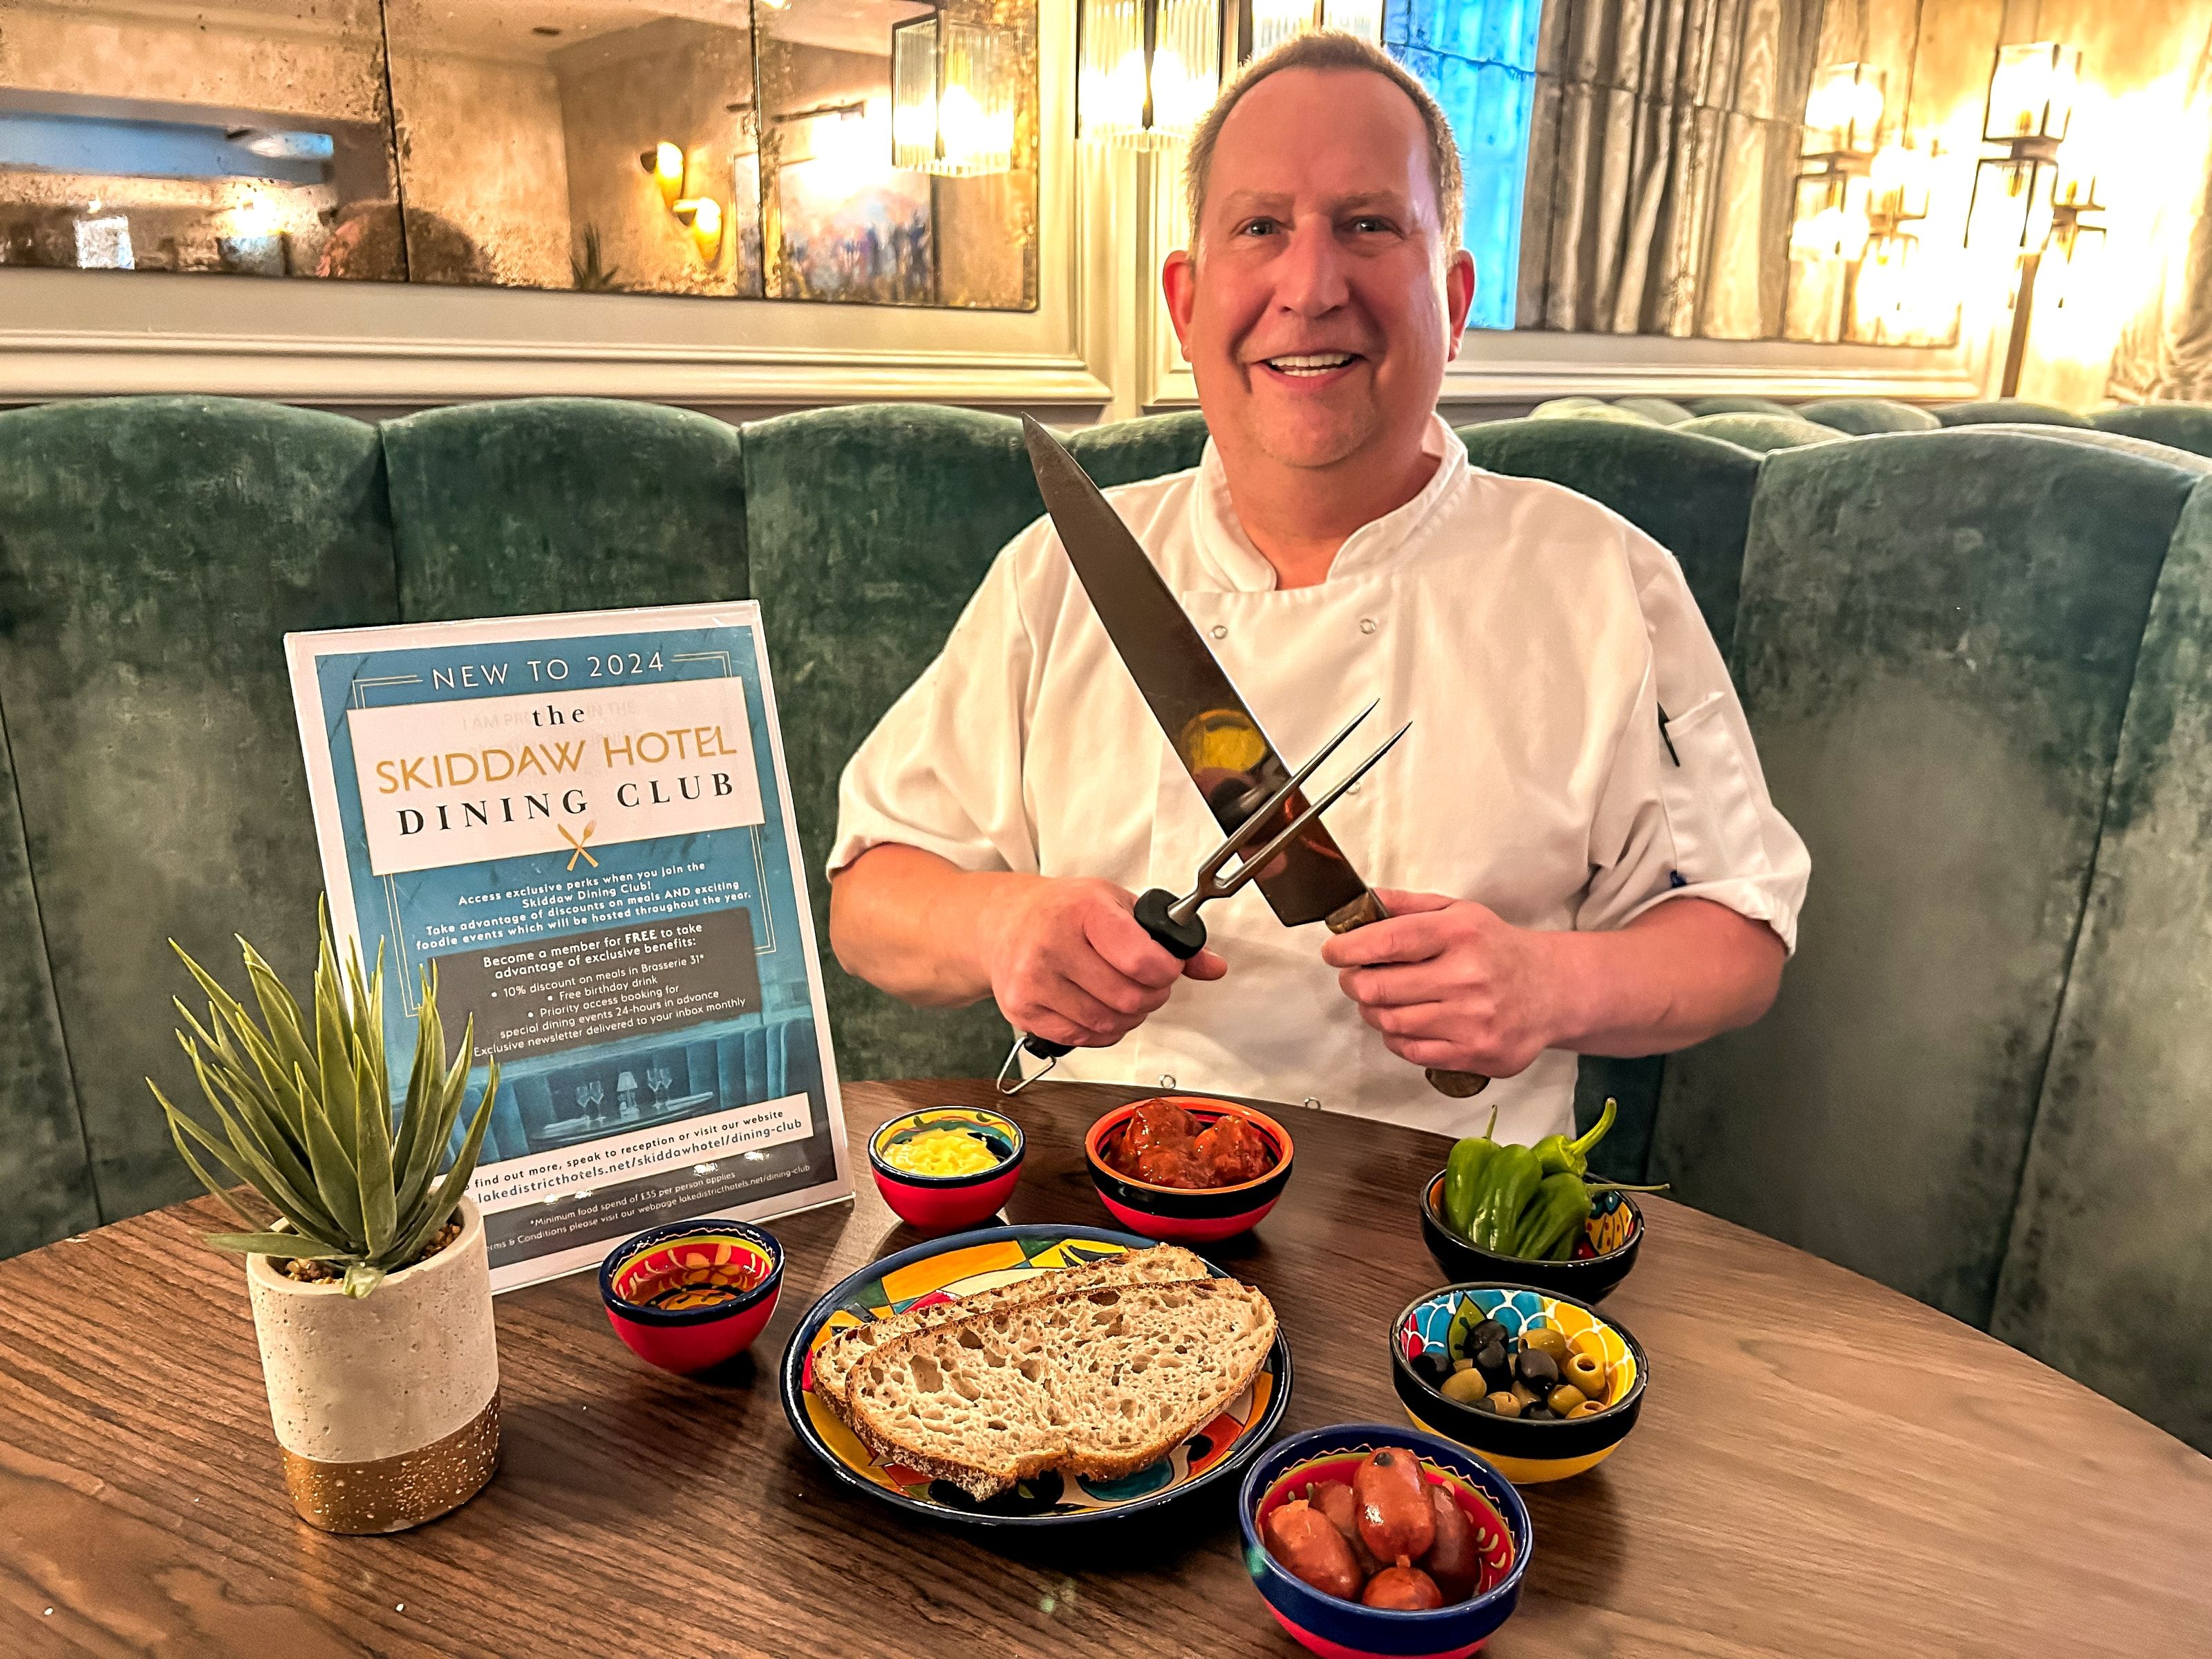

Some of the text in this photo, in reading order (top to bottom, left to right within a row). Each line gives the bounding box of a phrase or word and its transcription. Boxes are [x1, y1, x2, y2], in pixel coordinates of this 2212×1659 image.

[432, 652, 664, 690] NEW TO 2024
[532, 704, 585, 727] the
[376, 739, 587, 794] SKIDDAW
[603, 726, 737, 768] HOTEL
[396, 772, 733, 836] DINING CLUB
[458, 862, 705, 906] Access exclusive perks when you join the
[522, 881, 651, 909] Skiddaw Dining Club!
[416, 891, 751, 951] foodie events which will be hosted throughout the year.
[426, 881, 740, 937] Take advantage of discounts on meals AND exciting
[483, 924, 702, 968] Become a member for FREE to take
[495, 937, 697, 980] advantage of exclusive benefits:
[503, 984, 527, 997] 10%
[529, 977, 576, 993] discount
[579, 975, 593, 984] on
[596, 968, 626, 982] meals
[629, 966, 639, 975] in
[641, 957, 687, 973] Brasserie
[559, 975, 658, 1002] Free birthday drink
[500, 990, 720, 1040] special dining events 24-hours in advance
[540, 985, 679, 1018] Priority access booking for
[474, 997, 746, 1057] Exclusive newsletter delivered to your inbox monthly
[474, 1174, 499, 1188] find
[504, 1170, 524, 1181] out
[529, 1163, 563, 1177] more,
[567, 1152, 601, 1168] speak
[605, 1150, 617, 1159] to
[621, 1136, 675, 1155] reception
[694, 1126, 718, 1137] visit
[722, 1121, 740, 1131] our
[743, 1110, 783, 1125] website
[578, 1205, 599, 1217] food
[601, 1197, 627, 1210] spend
[629, 1194, 639, 1205] of
[640, 1190, 657, 1201] £35
[658, 1187, 673, 1198] per
[675, 1179, 704, 1194] person
[706, 1172, 735, 1185] applies
[517, 1226, 567, 1245] Conditions
[570, 1217, 598, 1233] please
[601, 1212, 619, 1223] visit
[621, 1210, 635, 1219] our
[638, 1199, 677, 1214] webpage
